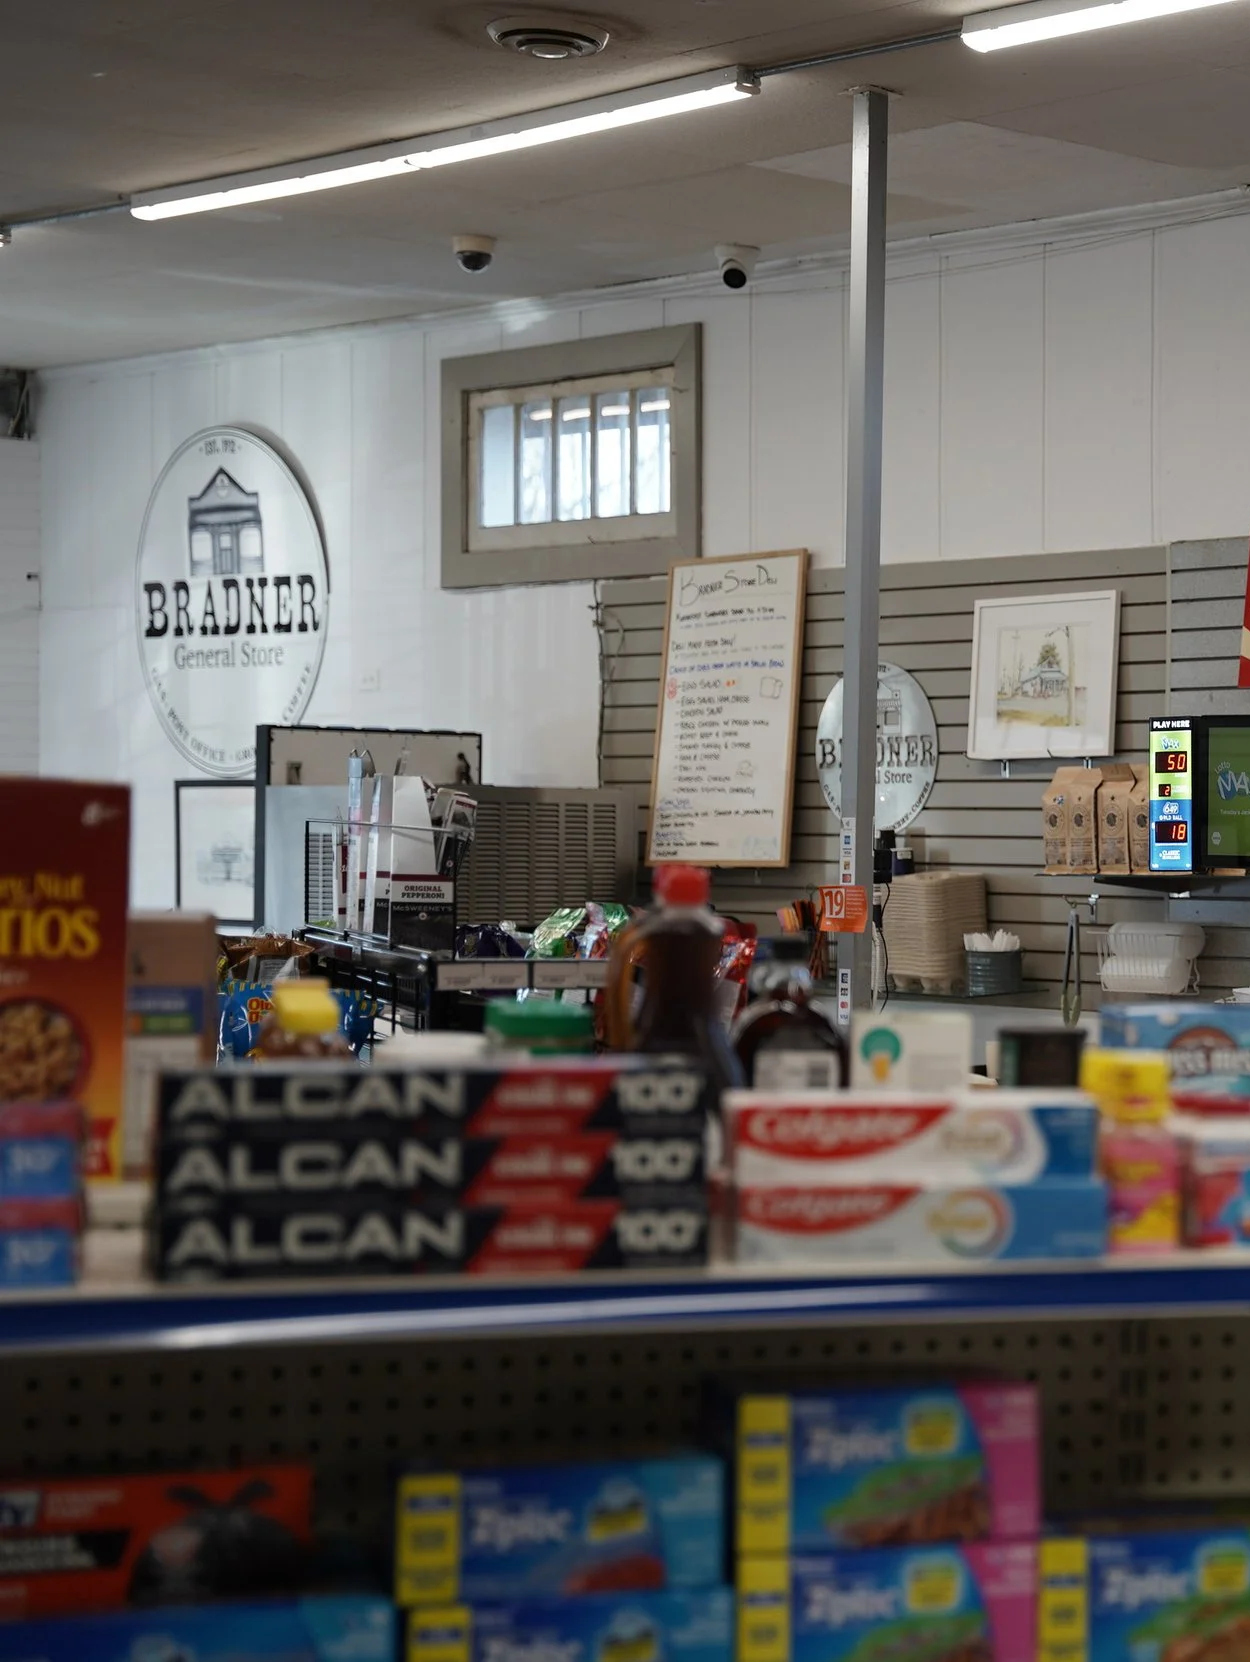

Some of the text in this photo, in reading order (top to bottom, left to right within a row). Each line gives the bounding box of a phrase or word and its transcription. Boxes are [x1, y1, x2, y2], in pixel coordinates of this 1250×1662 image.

[144, 575, 319, 638] BRADNER
[173, 641, 285, 670] General Store
[1153, 719, 1190, 729] PLAY HERE
[1167, 754, 1186, 770] 50
[884, 769, 912, 784] Store
[1164, 785, 1170, 796] 2
[1172, 823, 1187, 840] 18
[824, 890, 844, 916] 19
[170, 1073, 465, 1120] ALCAN
[747, 1110, 919, 1150] Colgate
[169, 1139, 464, 1190] ALCAN
[169, 1210, 465, 1264] ALCAN
